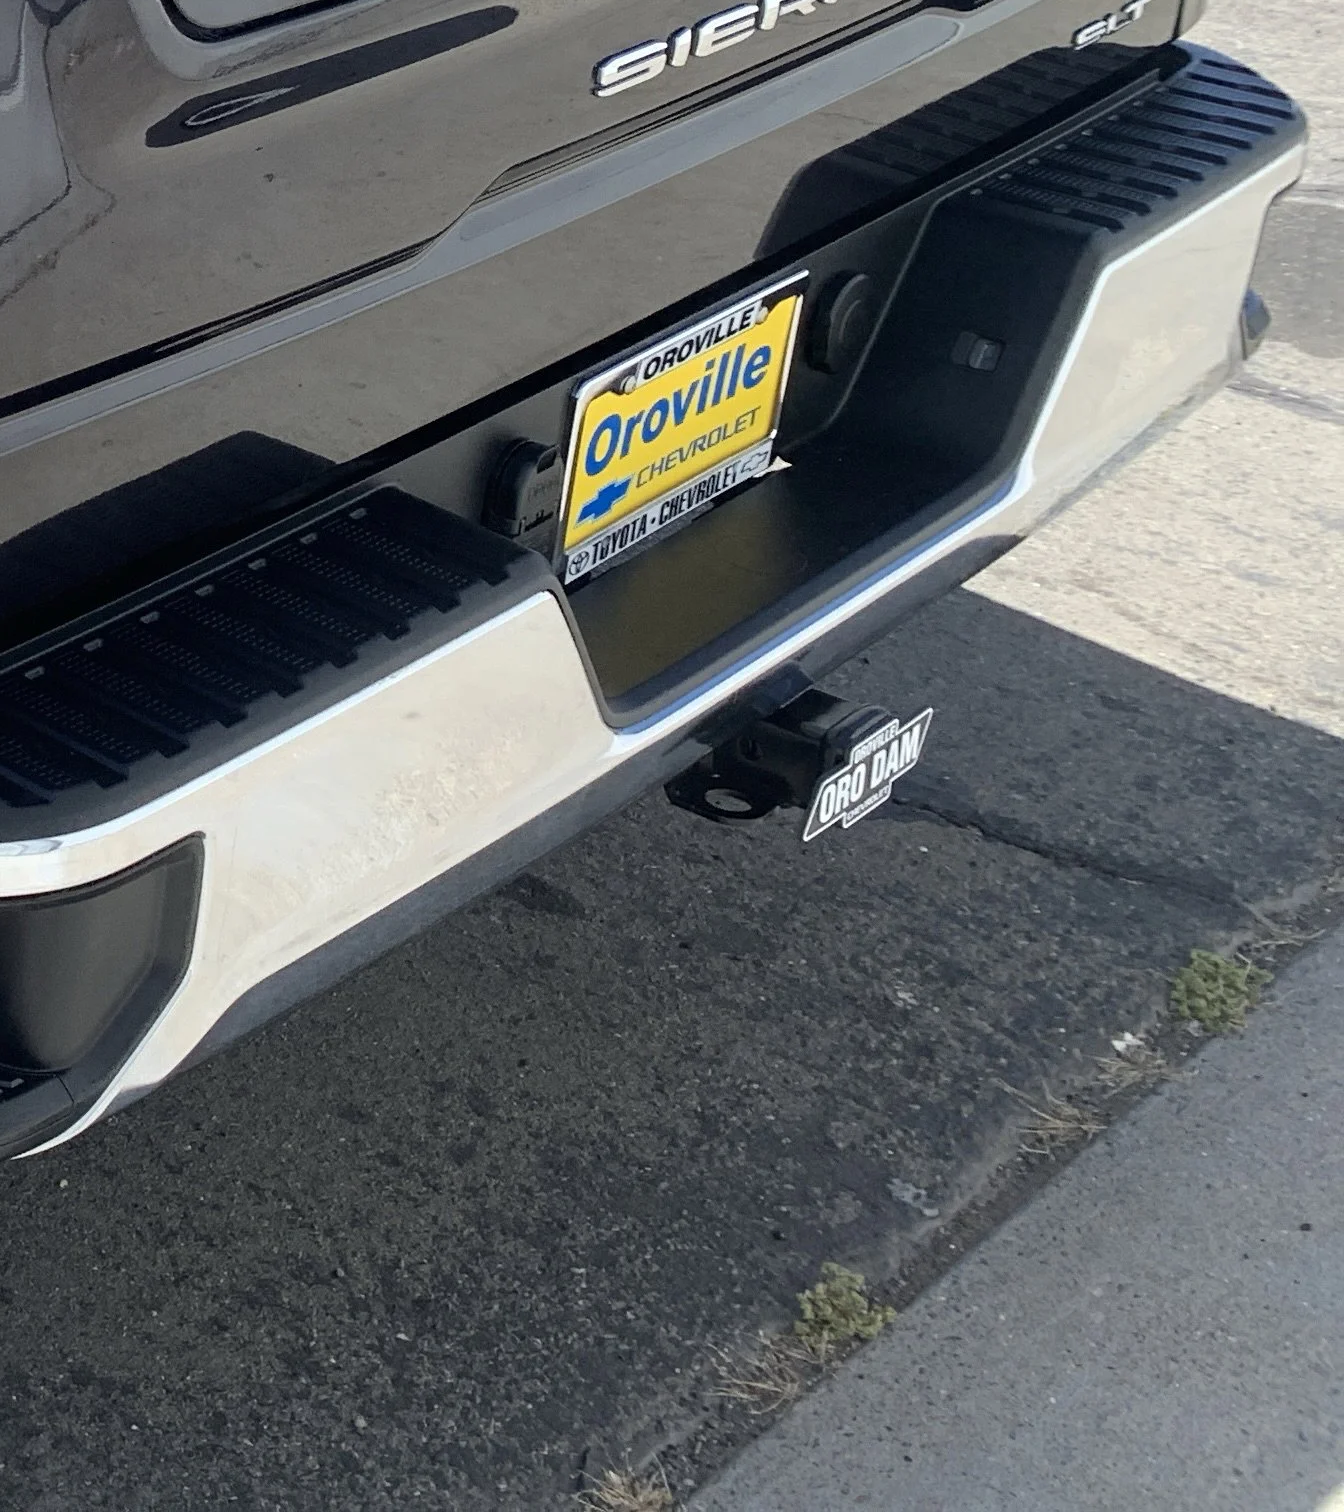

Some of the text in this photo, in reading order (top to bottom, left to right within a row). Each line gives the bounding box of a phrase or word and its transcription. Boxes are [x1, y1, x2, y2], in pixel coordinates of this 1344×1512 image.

[643, 306, 755, 381] OROVILLE
[584, 343, 772, 477] Oroville
[635, 406, 761, 489] CHEVROLET
[591, 459, 740, 565] TOYOTA CHEVROLET
[819, 722, 922, 824] ORO DAM
[853, 723, 897, 765] OROVILLE
